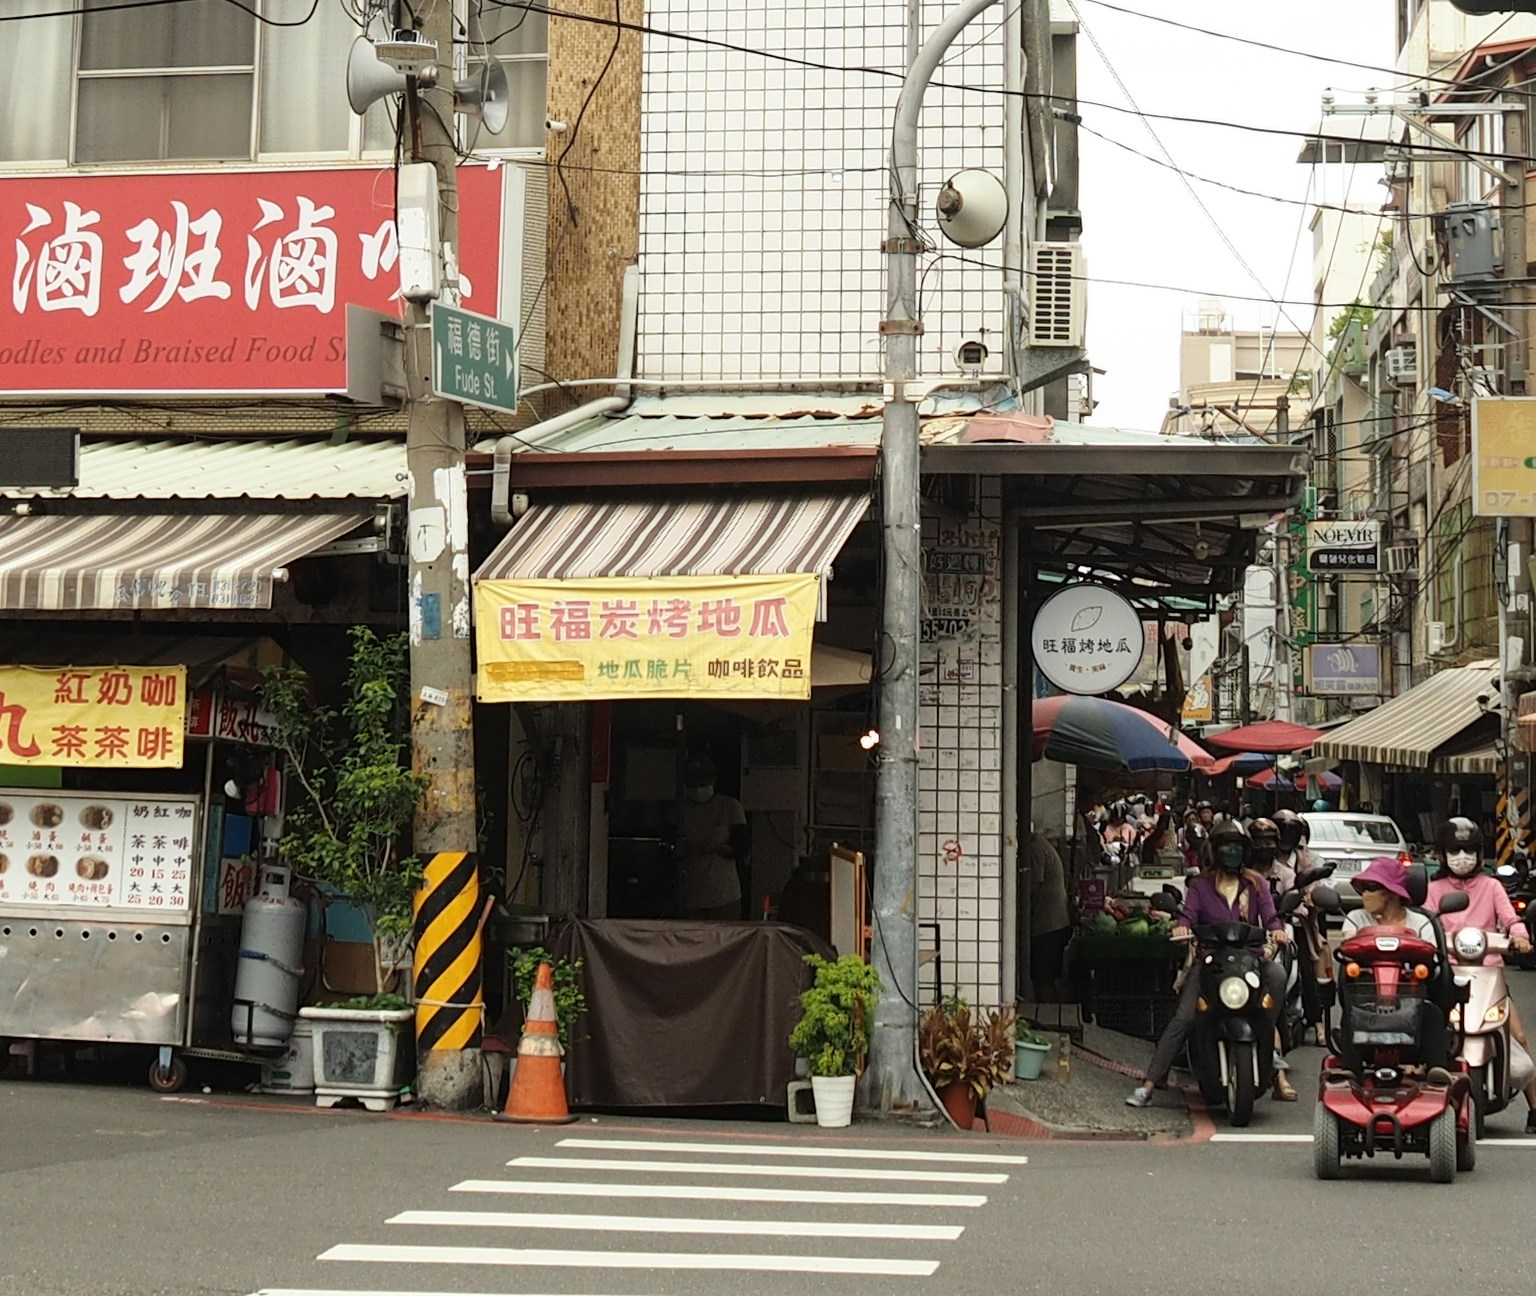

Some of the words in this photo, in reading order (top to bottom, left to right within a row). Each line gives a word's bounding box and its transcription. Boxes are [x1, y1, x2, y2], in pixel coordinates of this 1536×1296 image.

[75, 338, 124, 365] and
[132, 336, 240, 365] Braised
[244, 335, 317, 364] Food
[447, 316, 501, 366] 福德街
[455, 364, 480, 395] Fude
[484, 371, 498, 400] St.
[1314, 527, 1375, 544] NOEVIR
[498, 597, 792, 641] 旺福炭烤地瓜
[1042, 637, 1132, 655] 旺福烤地瓜
[597, 657, 693, 680] 地瓜脆片
[707, 657, 804, 680] 咖啡飲品
[131, 854, 144, 867] 中
[152, 855, 165, 868] 中
[173, 856, 186, 869] 中
[129, 867, 144, 878] 20
[150, 869, 164, 880] 15
[171, 869, 187, 881] 25
[129, 881, 142, 893] 大
[150, 882, 163, 894] 大
[171, 883, 184, 895] 大
[127, 894, 142, 905] 25
[148, 895, 164, 906] 20
[169, 896, 185, 907] 30
